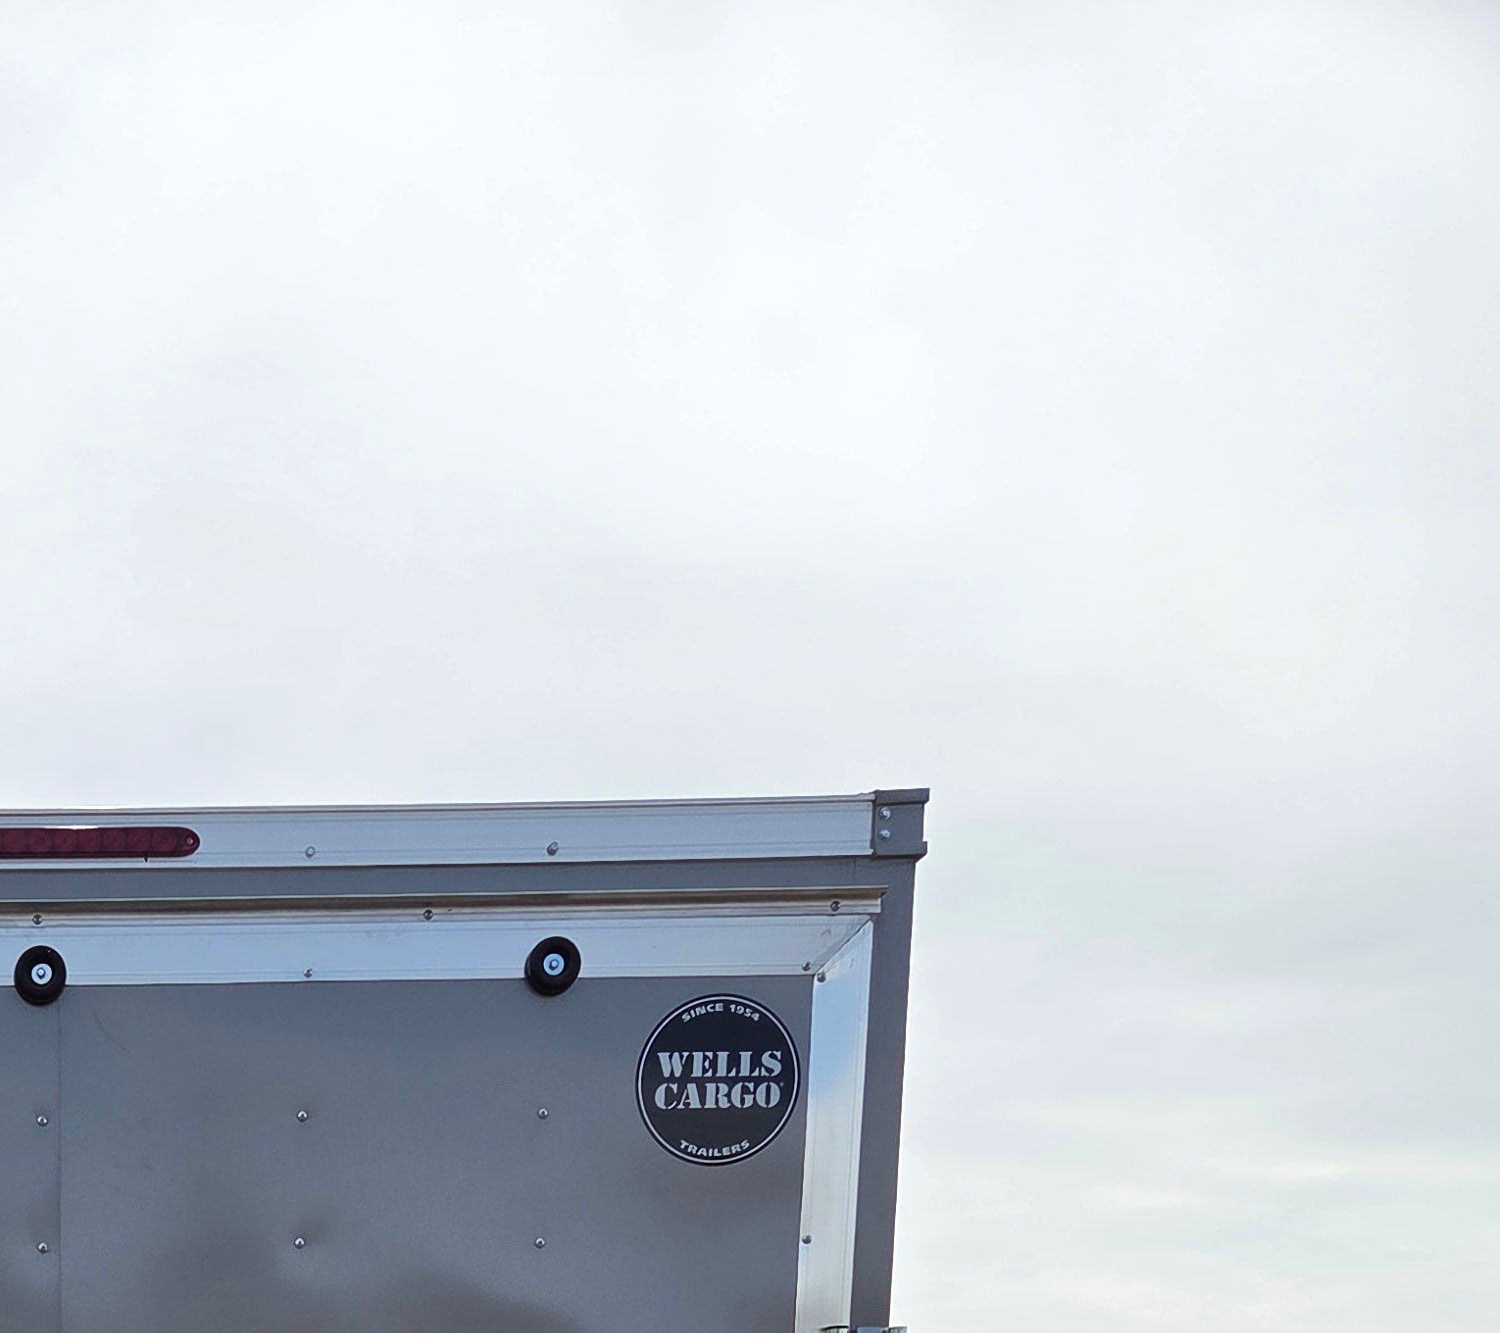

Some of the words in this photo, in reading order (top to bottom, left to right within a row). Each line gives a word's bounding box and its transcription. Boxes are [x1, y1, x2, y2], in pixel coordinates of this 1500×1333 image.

[681, 1002, 724, 1023] SINCE
[729, 1003, 760, 1022] 1954
[657, 1050, 782, 1078] WELLS
[654, 1081, 781, 1110] CARGO
[679, 1139, 751, 1157] TRAILERS
